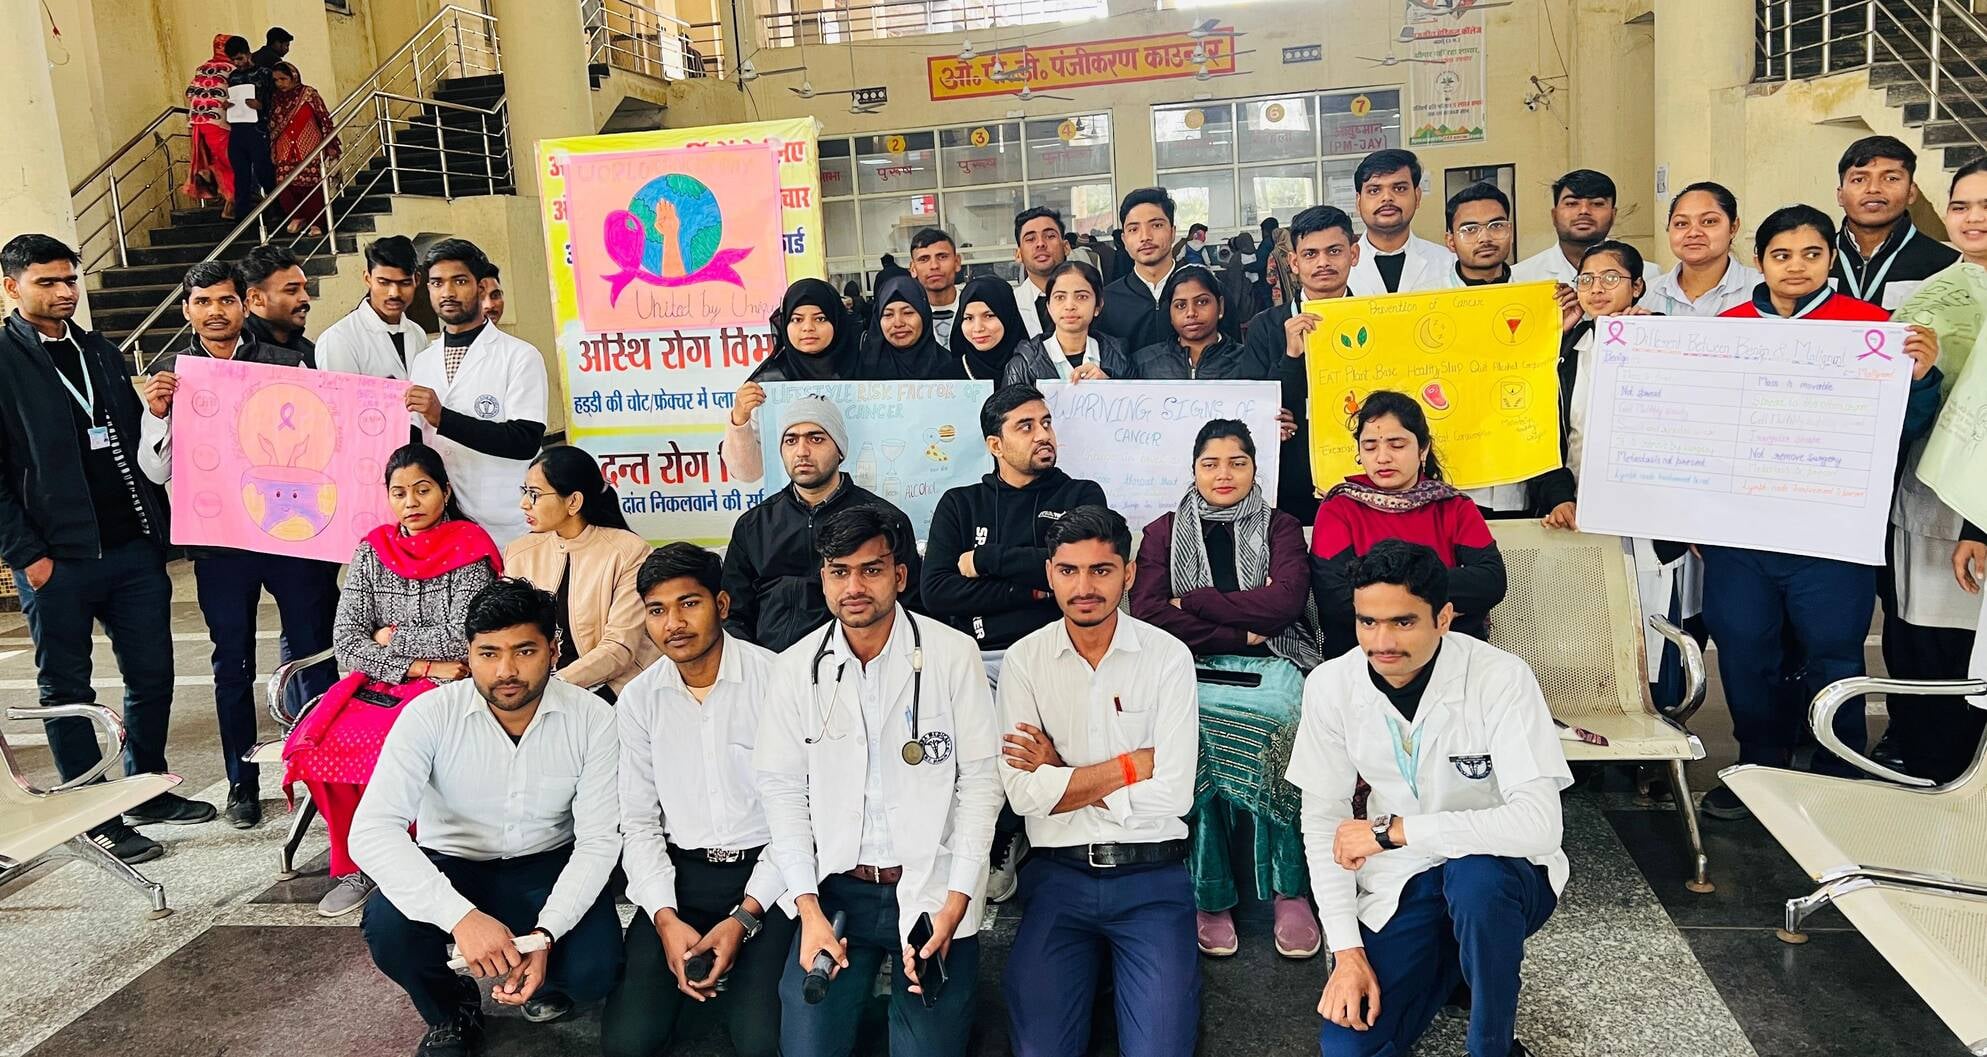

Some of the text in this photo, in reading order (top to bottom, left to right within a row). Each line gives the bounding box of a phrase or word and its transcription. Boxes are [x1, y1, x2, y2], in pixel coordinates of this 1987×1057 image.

[1049, 46, 1139, 77] पंजीकरण
[1356, 100, 1366, 112] 7
[892, 139, 899, 151] 2
[975, 131, 985, 144] 3
[781, 187, 810, 208] चार
[578, 327, 776, 373] अस्थि रोग विभ
[606, 390, 623, 412] की
[697, 387, 709, 410] में
[712, 391, 736, 409] प्ला
[857, 384, 896, 401] RISK
[845, 404, 904, 420] CANCER
[1050, 392, 1256, 424] WARNING SIGNS OF
[1114, 427, 1162, 447] CANCER
[599, 453, 650, 486] दन्त
[658, 441, 709, 484] रोग
[722, 488, 741, 510] की
